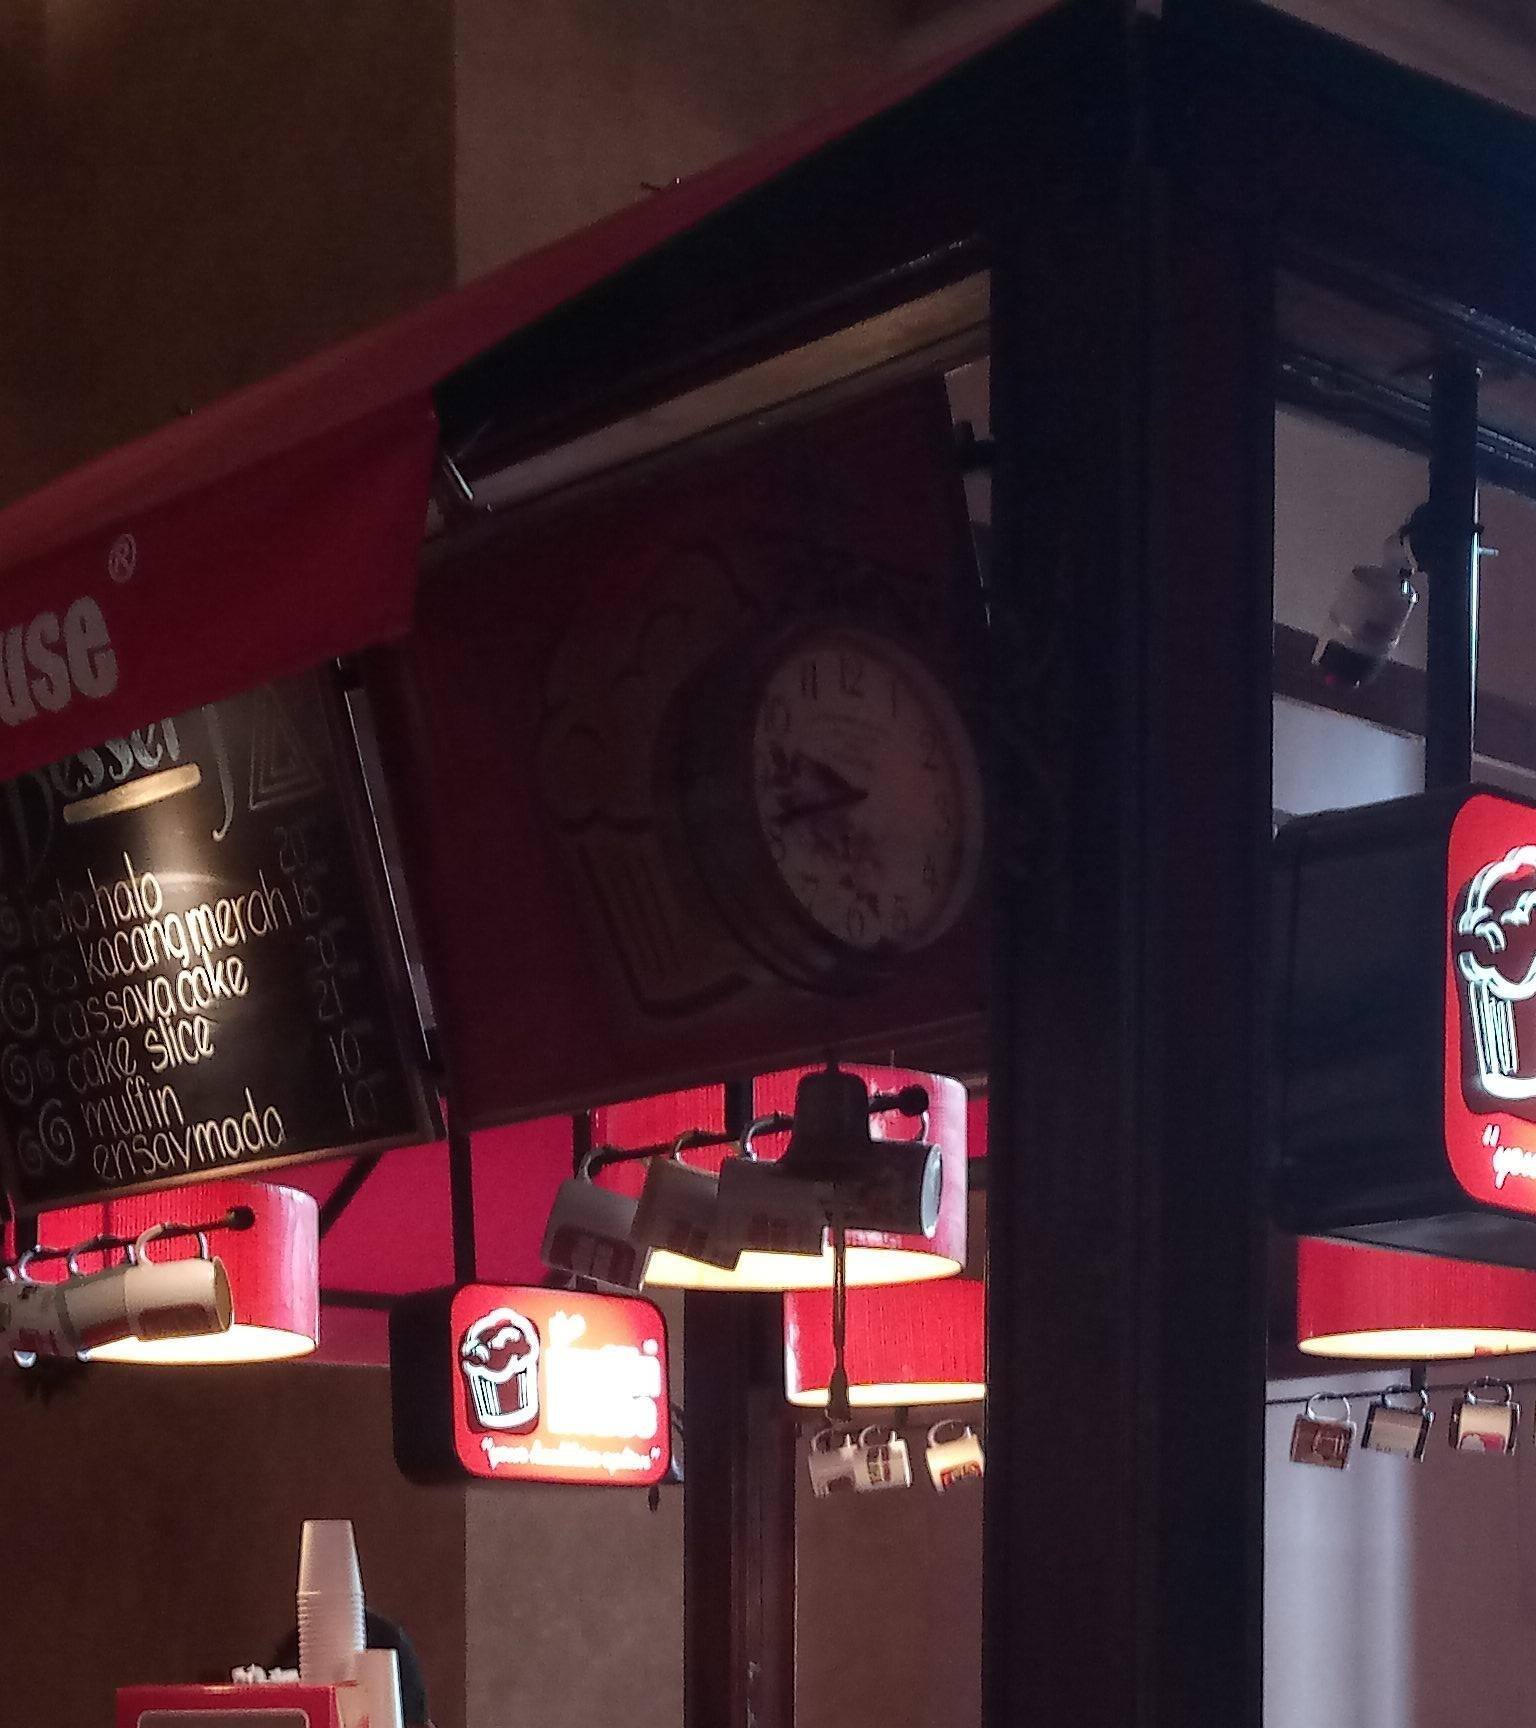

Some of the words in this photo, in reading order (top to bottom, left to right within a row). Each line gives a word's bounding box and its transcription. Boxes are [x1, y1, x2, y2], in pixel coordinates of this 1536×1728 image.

[76, 911, 191, 986] kacang
[184, 868, 294, 958] merah
[52, 973, 178, 1047] cassava
[66, 1036, 139, 1095] cake
[144, 1014, 217, 1074] slice
[80, 1074, 186, 1139] muffin
[92, 1086, 288, 1180] ensaymada
